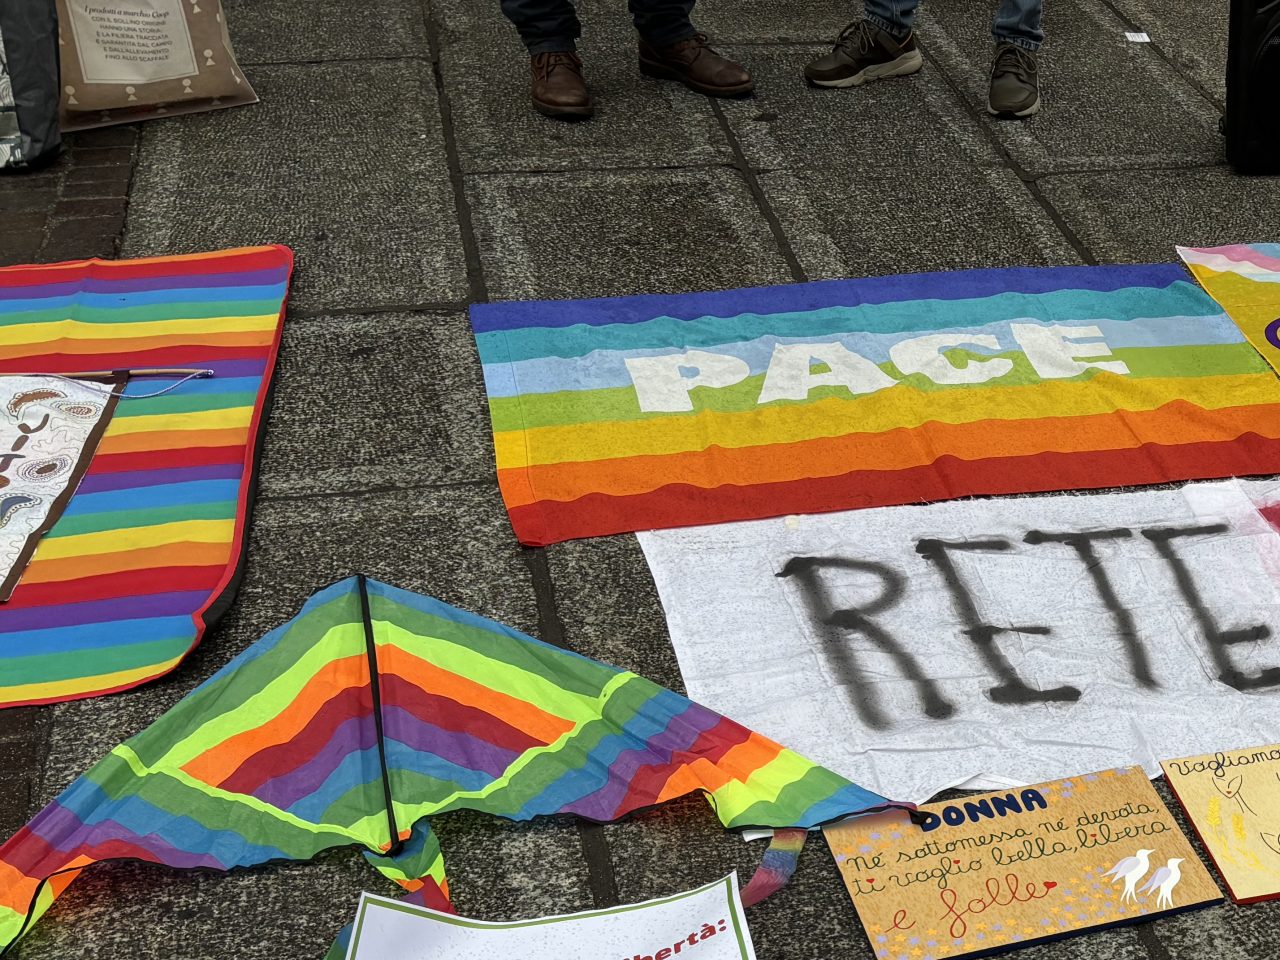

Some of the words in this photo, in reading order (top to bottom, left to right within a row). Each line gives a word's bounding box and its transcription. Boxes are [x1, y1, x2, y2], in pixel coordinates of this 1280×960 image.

[623, 322, 1130, 413] PACE
[896, 828, 1032, 862] sottomessa
[1076, 802, 1159, 828] devota,
[920, 789, 1048, 832] DONNA
[852, 878, 886, 896] ti
[889, 856, 982, 889] voglio
[992, 837, 1078, 865] bella,
[1076, 822, 1171, 848] libera
[884, 910, 916, 933] e
[939, 873, 1052, 938] folle
